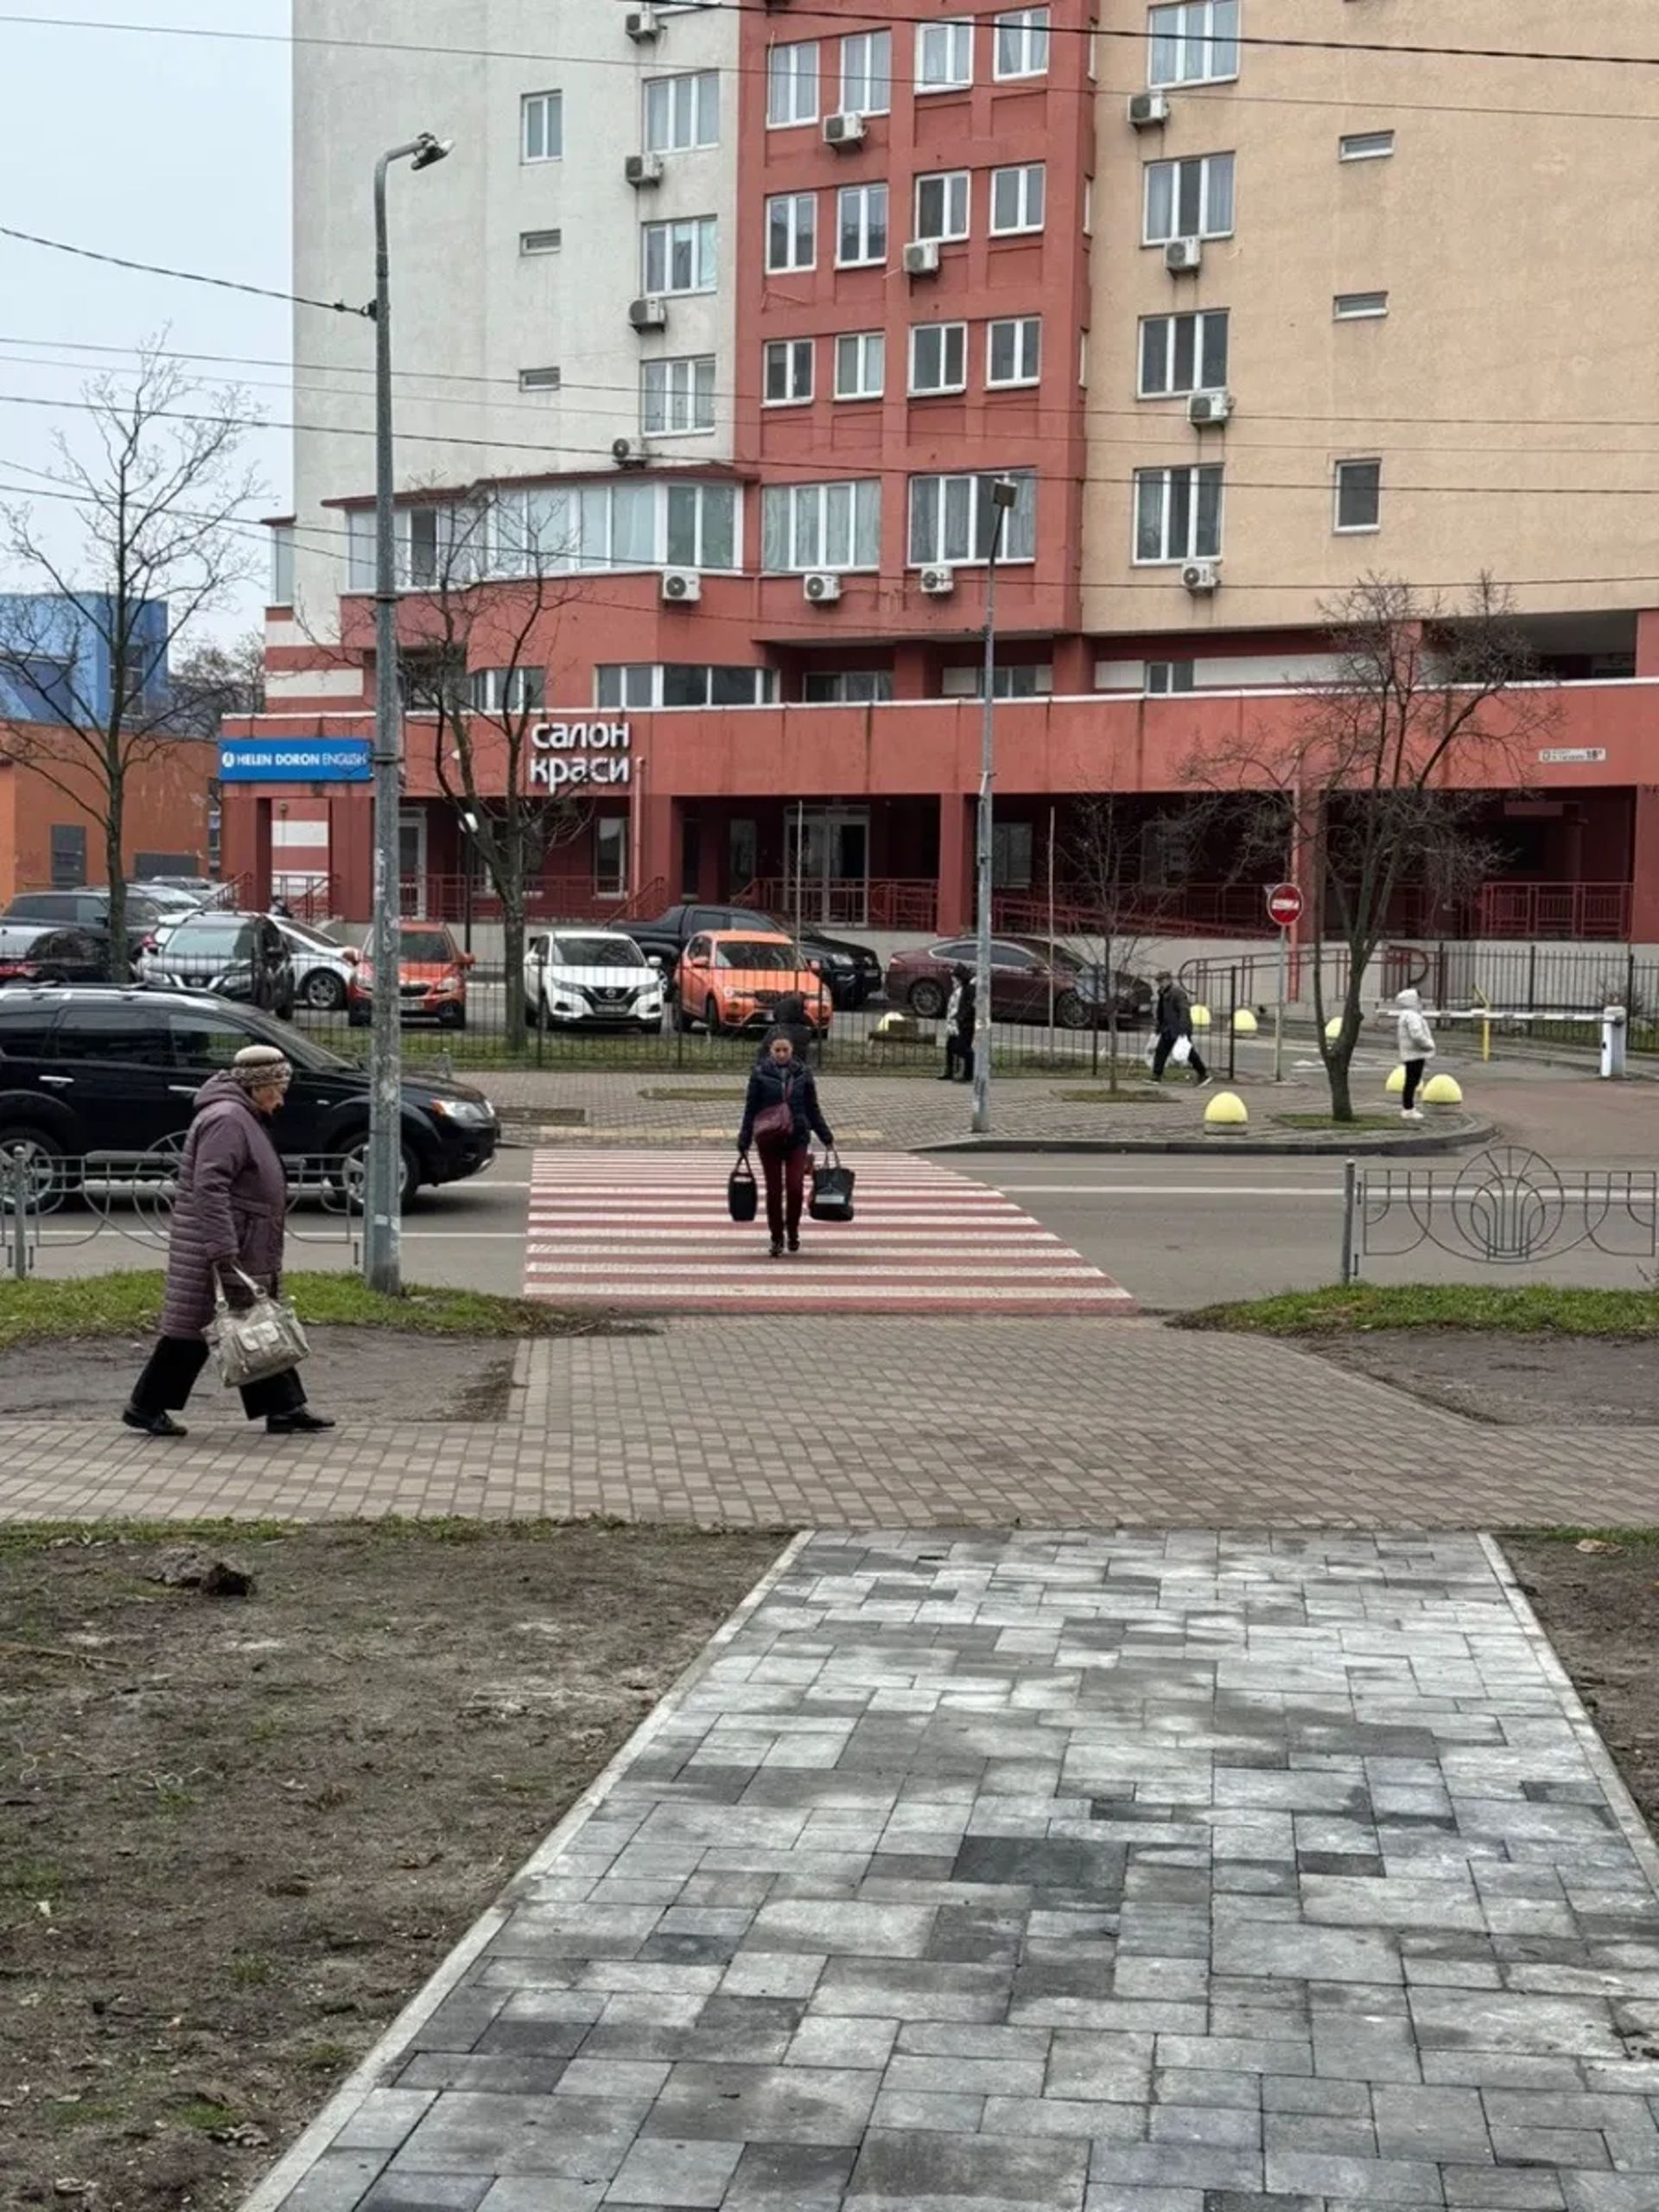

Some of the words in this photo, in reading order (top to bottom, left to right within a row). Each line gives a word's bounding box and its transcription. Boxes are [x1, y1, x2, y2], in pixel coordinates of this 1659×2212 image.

[531, 721, 630, 749] салон
[237, 753, 271, 766] HELEN
[276, 753, 320, 766] DORON
[321, 752, 366, 766] ENGLISH
[530, 756, 630, 794] краси
